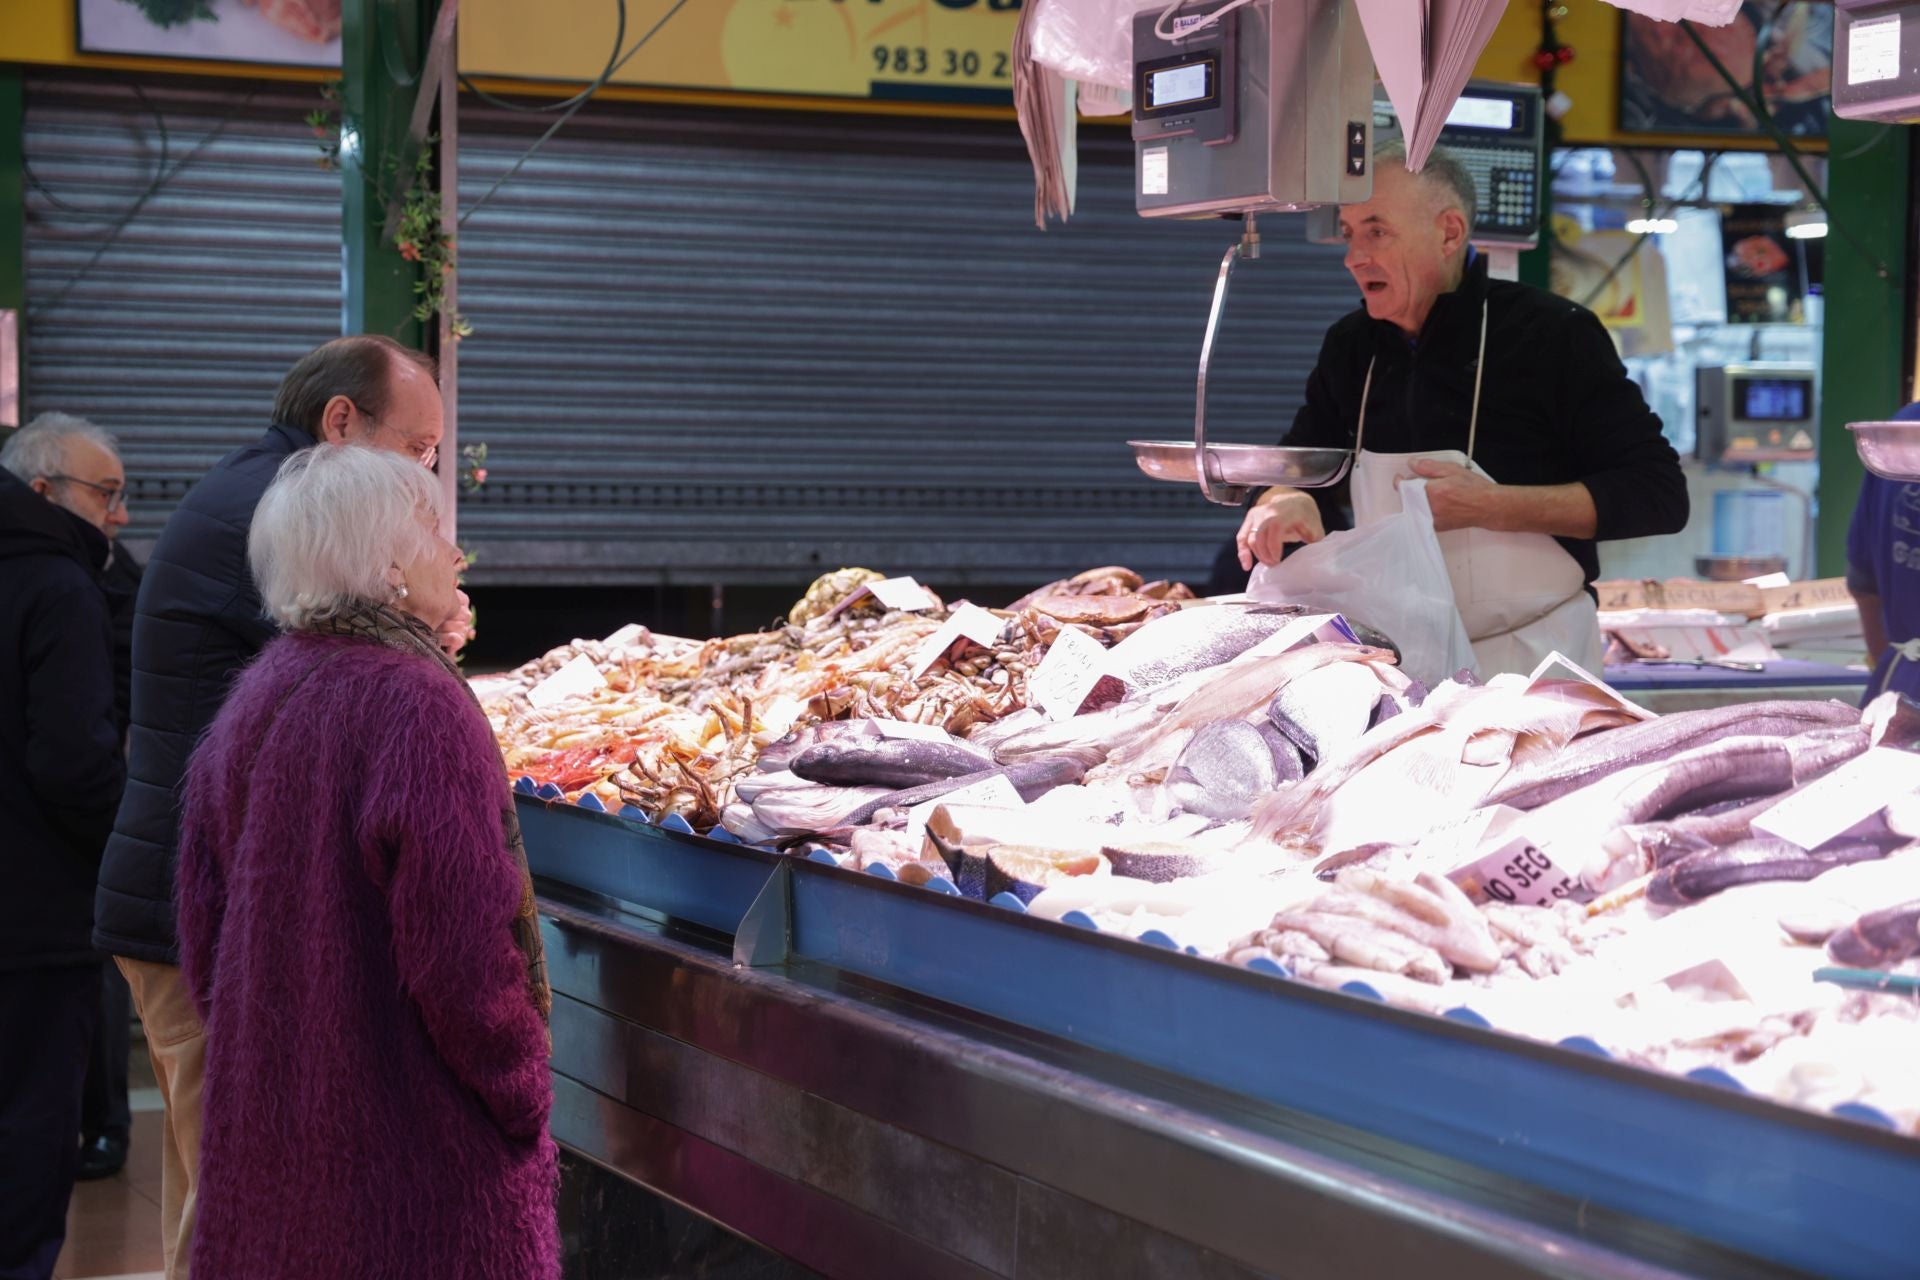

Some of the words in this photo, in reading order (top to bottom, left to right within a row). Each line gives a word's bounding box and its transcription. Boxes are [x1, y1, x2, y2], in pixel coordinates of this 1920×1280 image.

[873, 45, 928, 74] 983
[944, 49, 980, 77] 30
[992, 51, 1012, 78] 2
[1504, 846, 1552, 888] SEG
